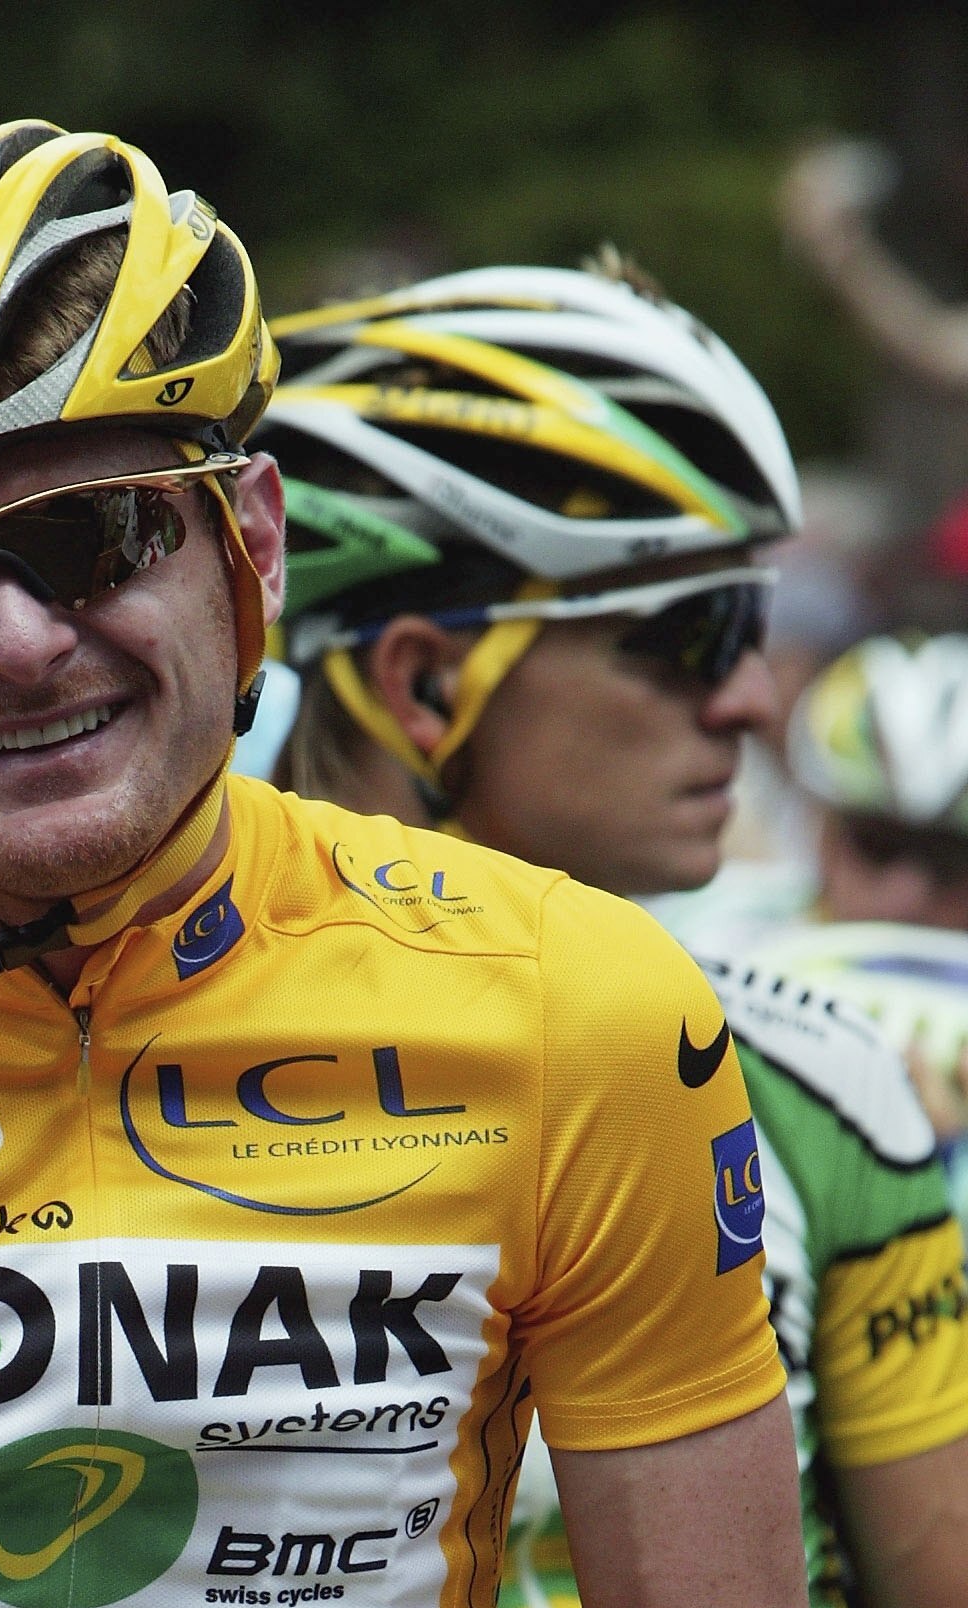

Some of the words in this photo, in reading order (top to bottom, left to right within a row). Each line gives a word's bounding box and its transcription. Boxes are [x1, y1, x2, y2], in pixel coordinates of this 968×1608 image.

[156, 1045, 466, 1129] LCL
[232, 1142, 260, 1159] LE
[267, 1136, 365, 1159] CRÉDIT
[372, 1126, 509, 1151] LYONNAIS
[196, 1395, 450, 1447] systems
[205, 1526, 398, 1576] BMC
[205, 1586, 271, 1605] swiss
[276, 1583, 345, 1608] cycles
